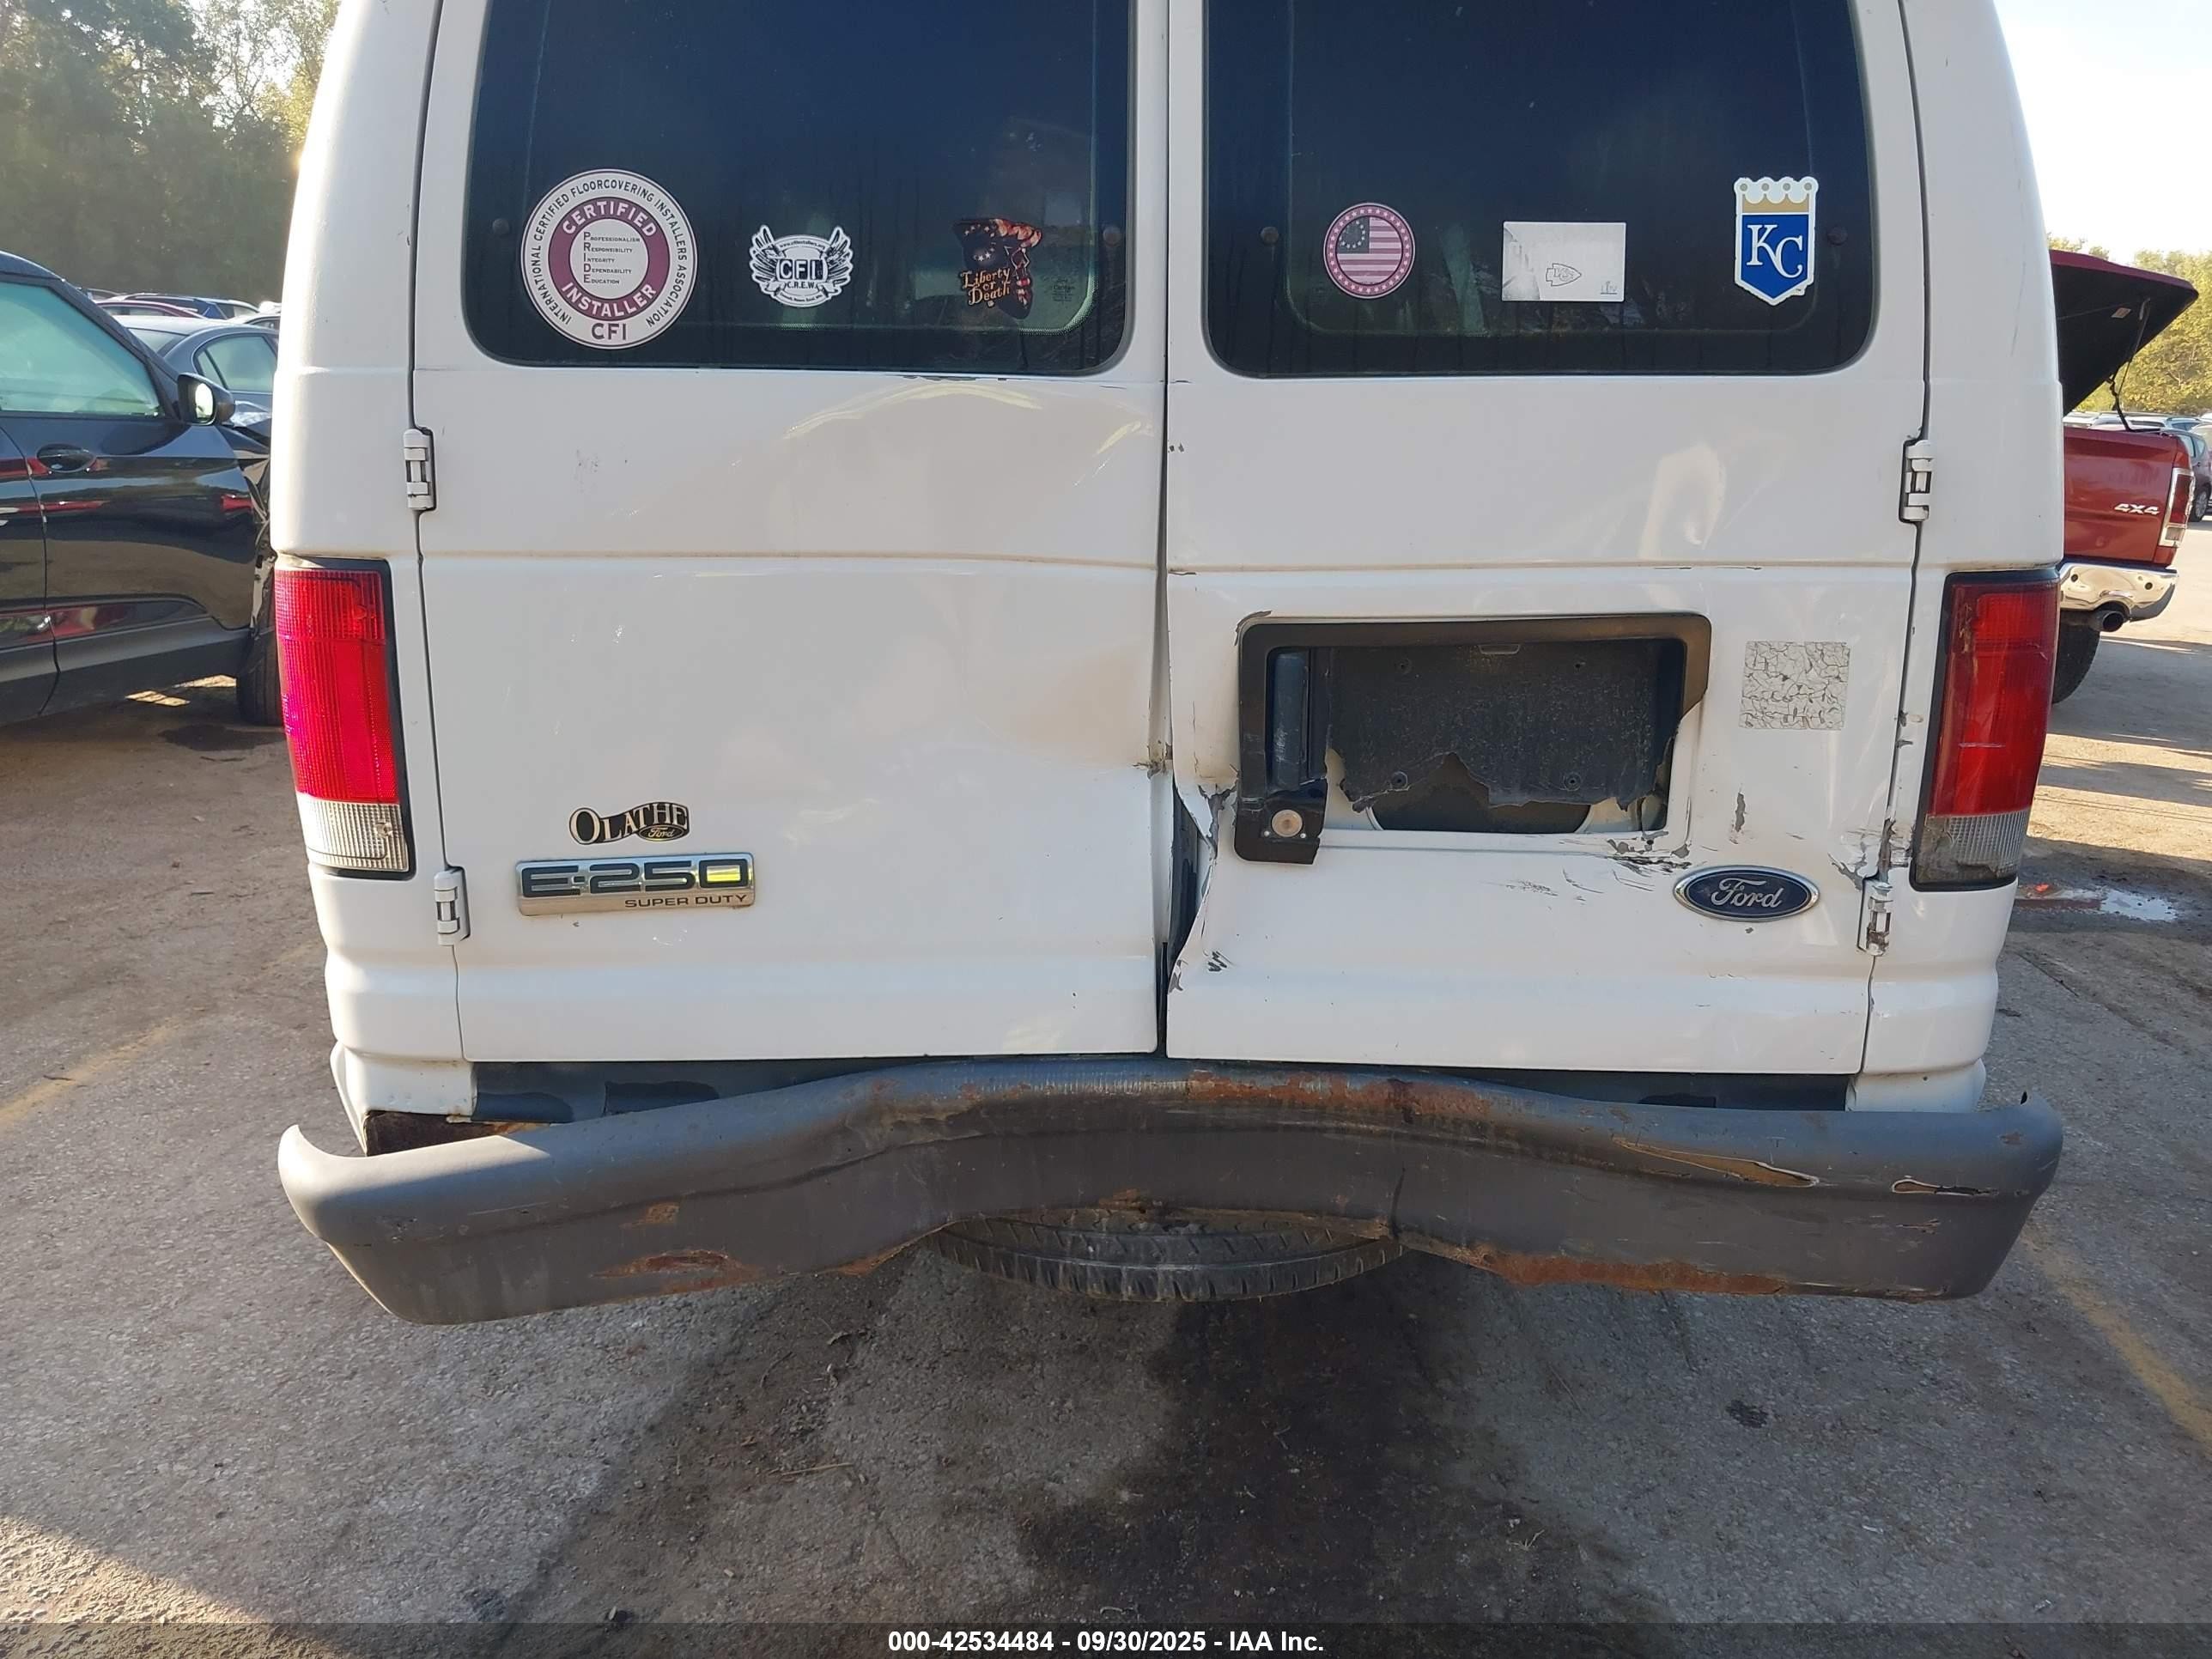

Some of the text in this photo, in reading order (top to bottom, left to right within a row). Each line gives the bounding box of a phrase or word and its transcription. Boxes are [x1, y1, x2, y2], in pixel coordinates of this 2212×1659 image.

[562, 201, 657, 236] CERTIFIED
[531, 179, 688, 328] INTERNATIONAL CERTIFIED FLOORCOVERING INSTALLERS ASSOCIATION
[1747, 225, 1802, 278] KC
[780, 260, 817, 280] CFI
[960, 267, 1011, 289] Liberty
[968, 280, 1011, 306] Death
[982, 281, 996, 291] or
[562, 283, 657, 318] INSTALLER
[591, 322, 627, 340] CFI
[569, 803, 688, 844] OLATHE
[647, 827, 676, 838] Ford
[521, 859, 750, 898] E-250
[624, 894, 748, 908] SUPER DUTY
[1711, 878, 1784, 908] Ford
